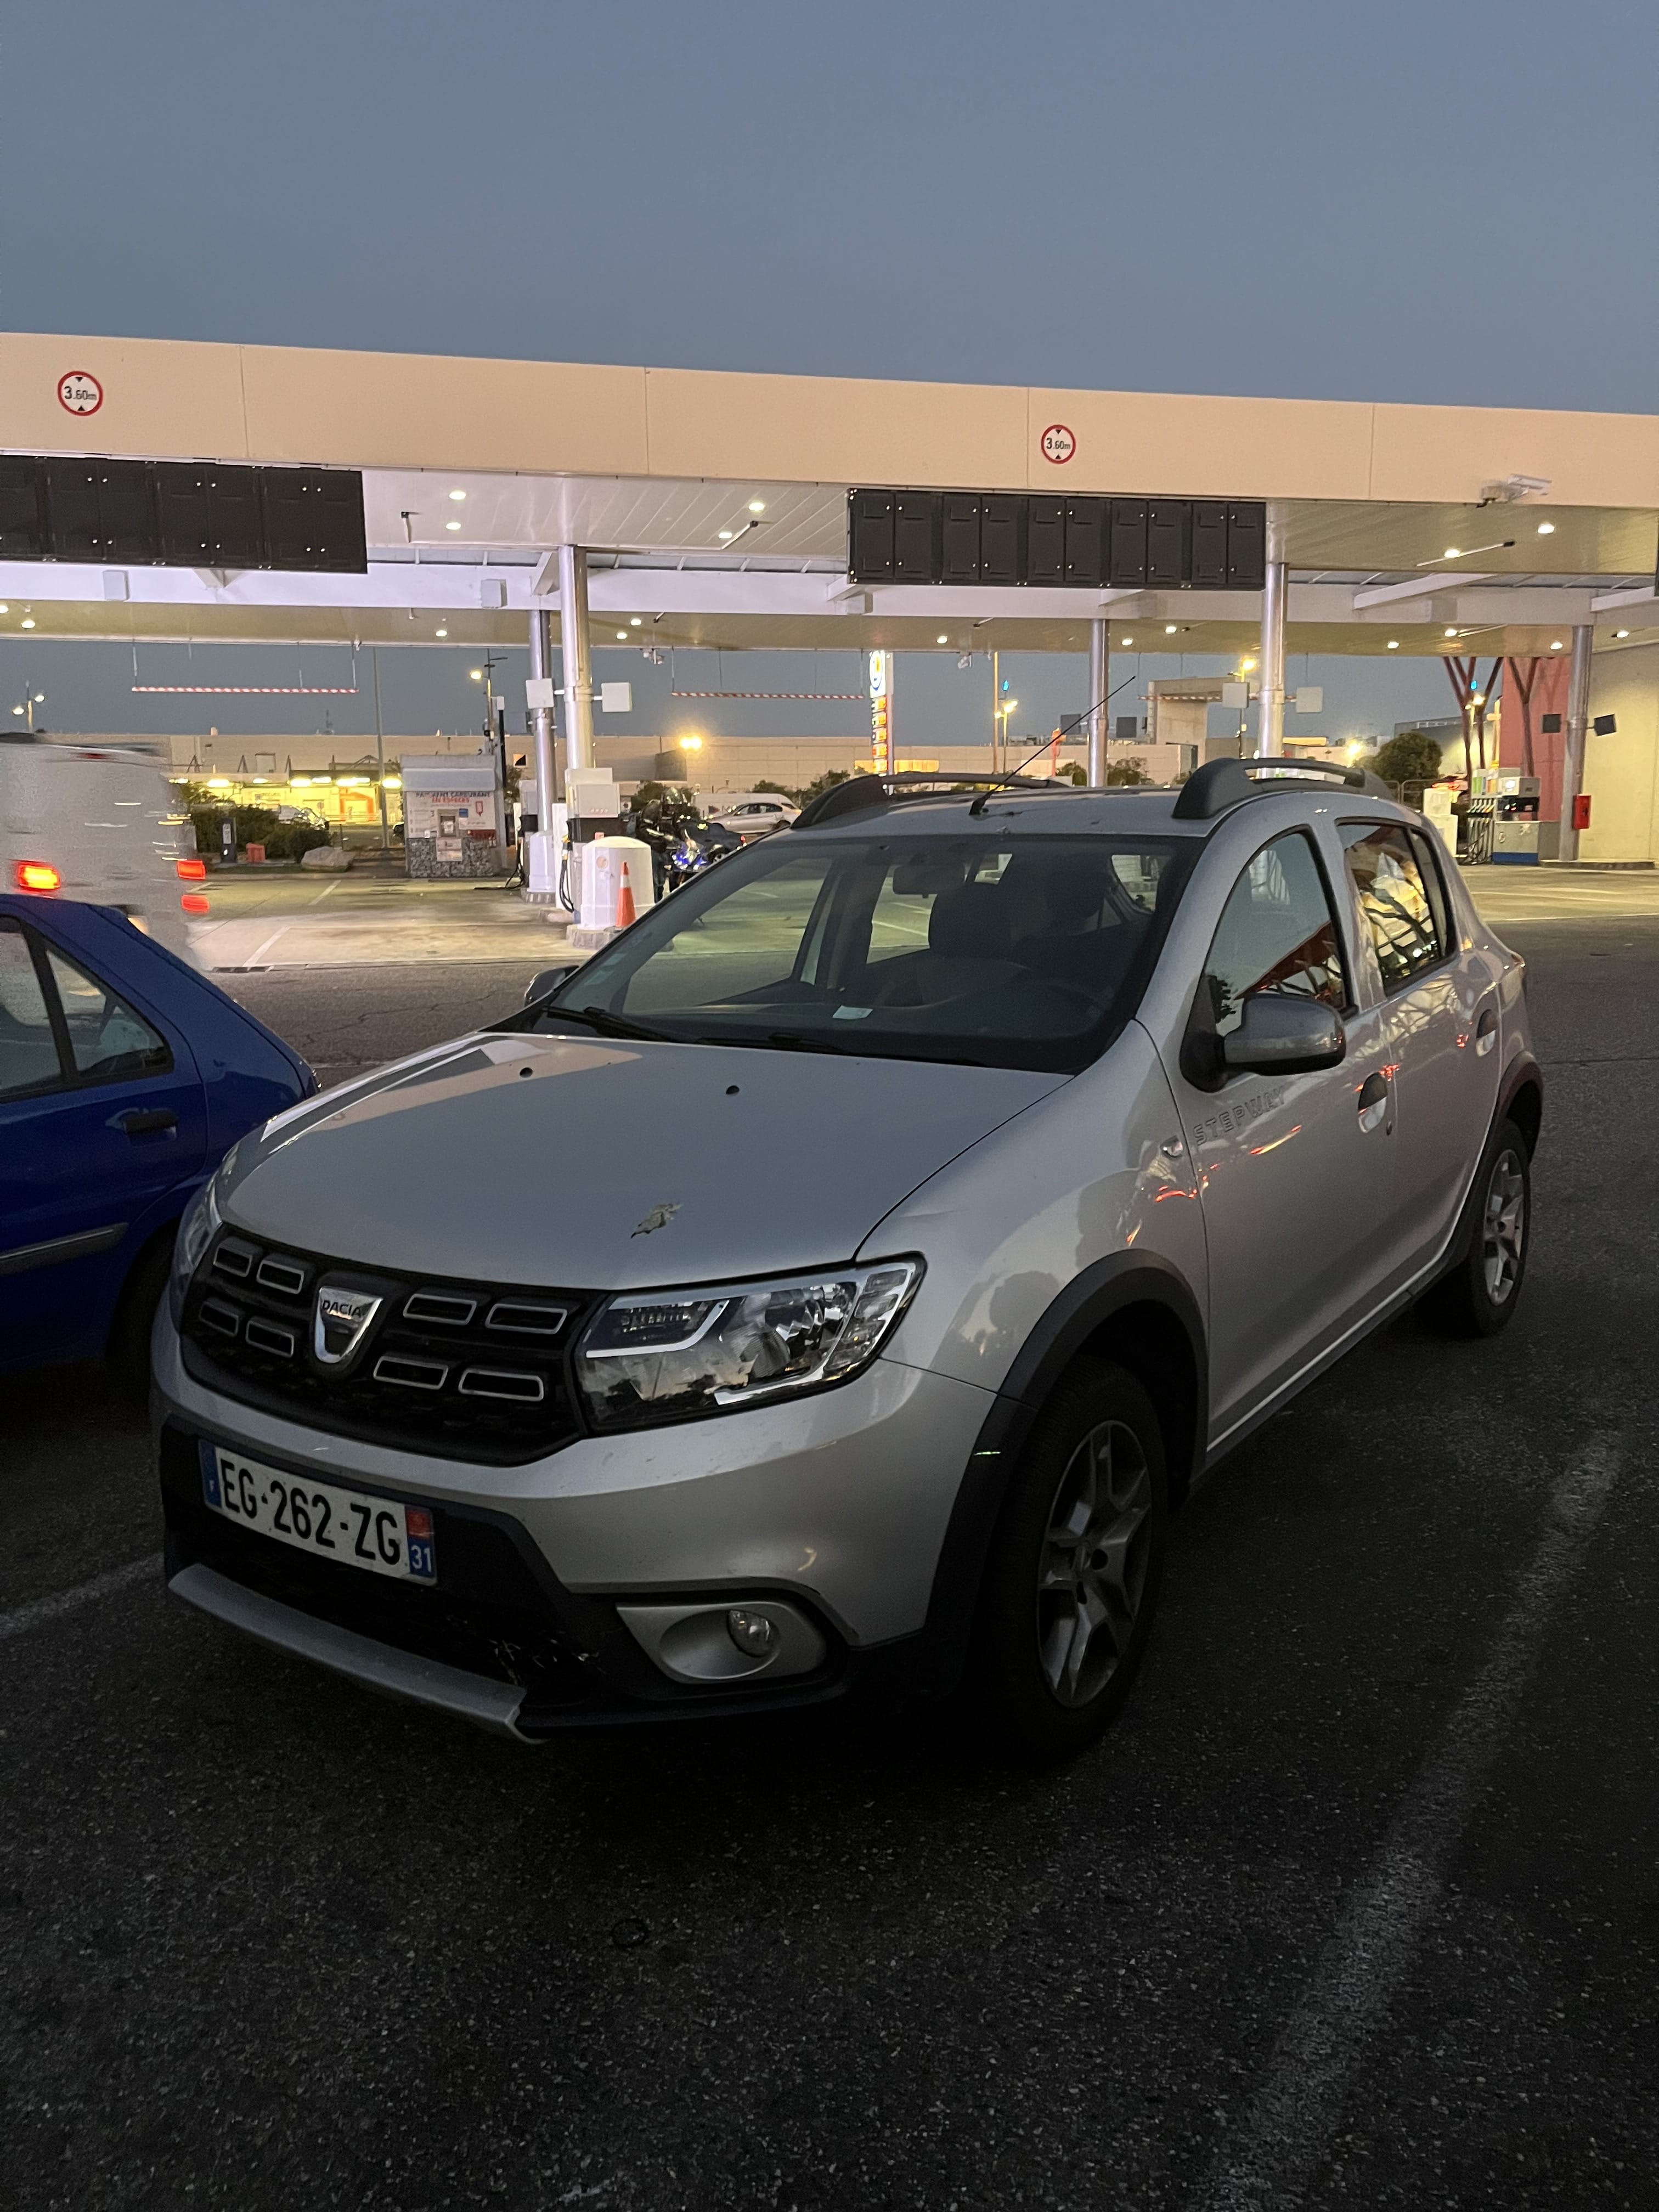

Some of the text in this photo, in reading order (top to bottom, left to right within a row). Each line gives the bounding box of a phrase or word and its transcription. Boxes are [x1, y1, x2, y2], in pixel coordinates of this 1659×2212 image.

[1193, 1086, 1285, 1146] STEPWAY
[323, 1300, 362, 1317] DACIA
[411, 1545, 431, 1572] 31
